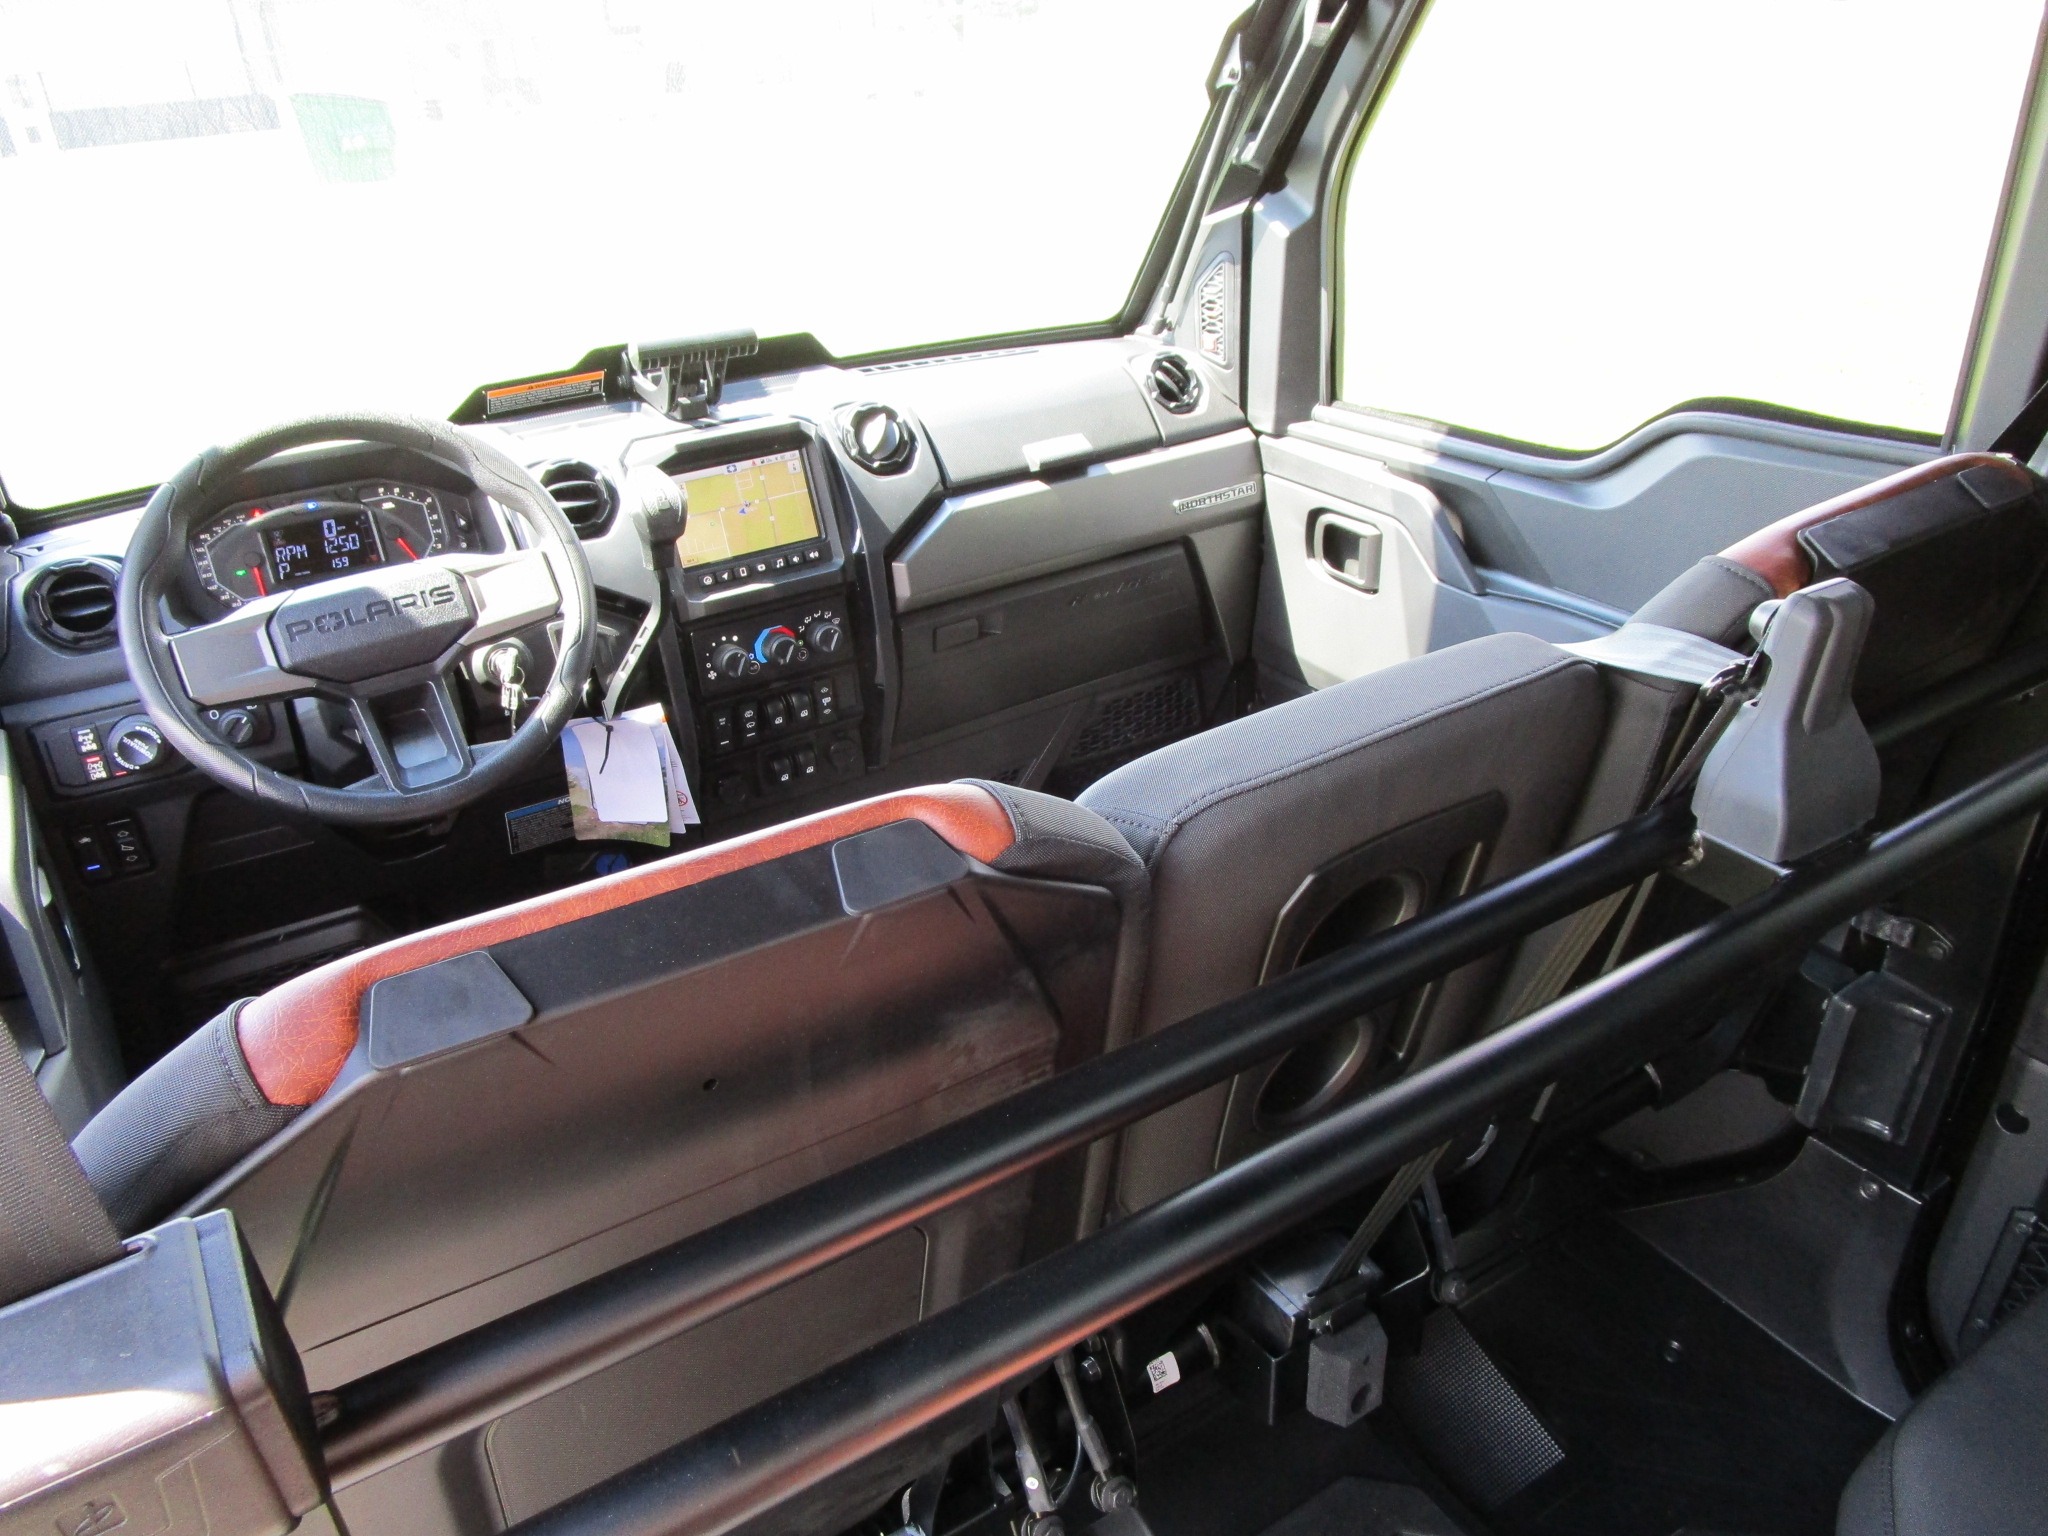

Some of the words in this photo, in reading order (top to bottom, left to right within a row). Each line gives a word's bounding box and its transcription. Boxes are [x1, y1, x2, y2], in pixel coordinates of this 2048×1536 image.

[1180, 484, 1254, 511] NORTHSTAR
[323, 519, 337, 538] 0
[275, 544, 308, 562] RPM
[324, 533, 360, 554] 1250
[279, 562, 290, 580] P
[332, 556, 349, 568] 159
[285, 584, 456, 643] POLARIS
